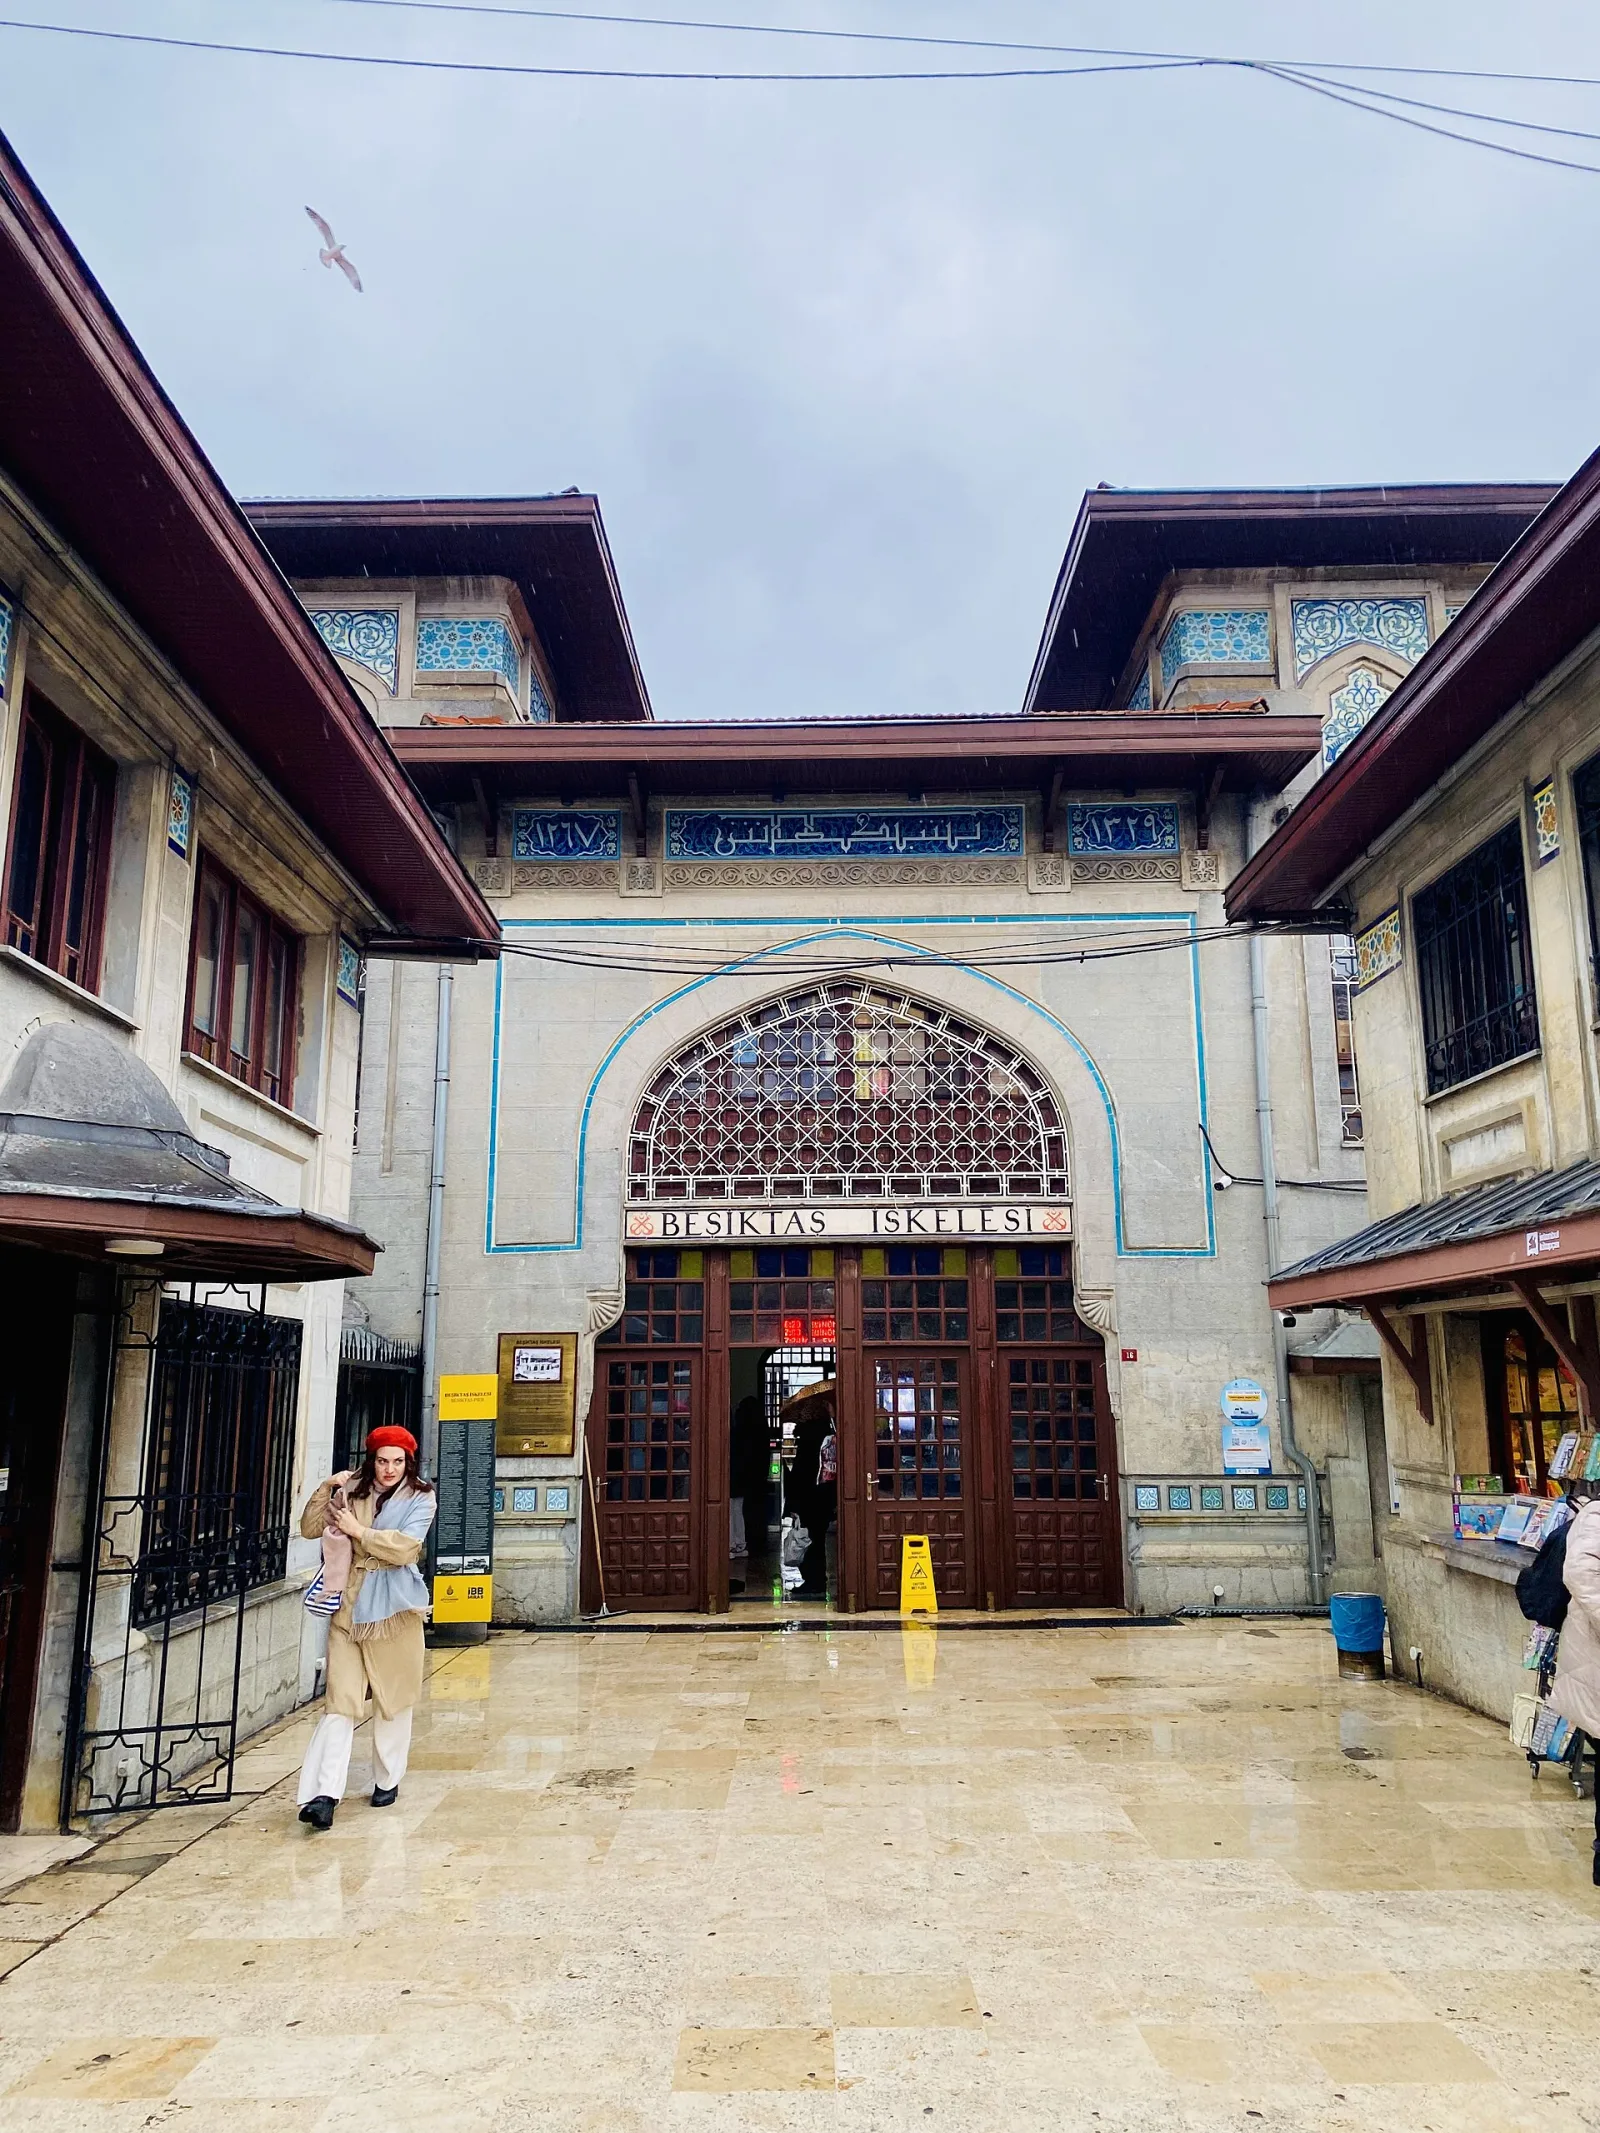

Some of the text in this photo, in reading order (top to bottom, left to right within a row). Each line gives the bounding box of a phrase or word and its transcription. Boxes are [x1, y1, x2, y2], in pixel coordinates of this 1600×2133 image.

[535, 821, 602, 849] ١٢٦٧
[1091, 813, 1158, 843] ١٣٢٩
[661, 1208, 826, 1238] BEŞİKTAŞ
